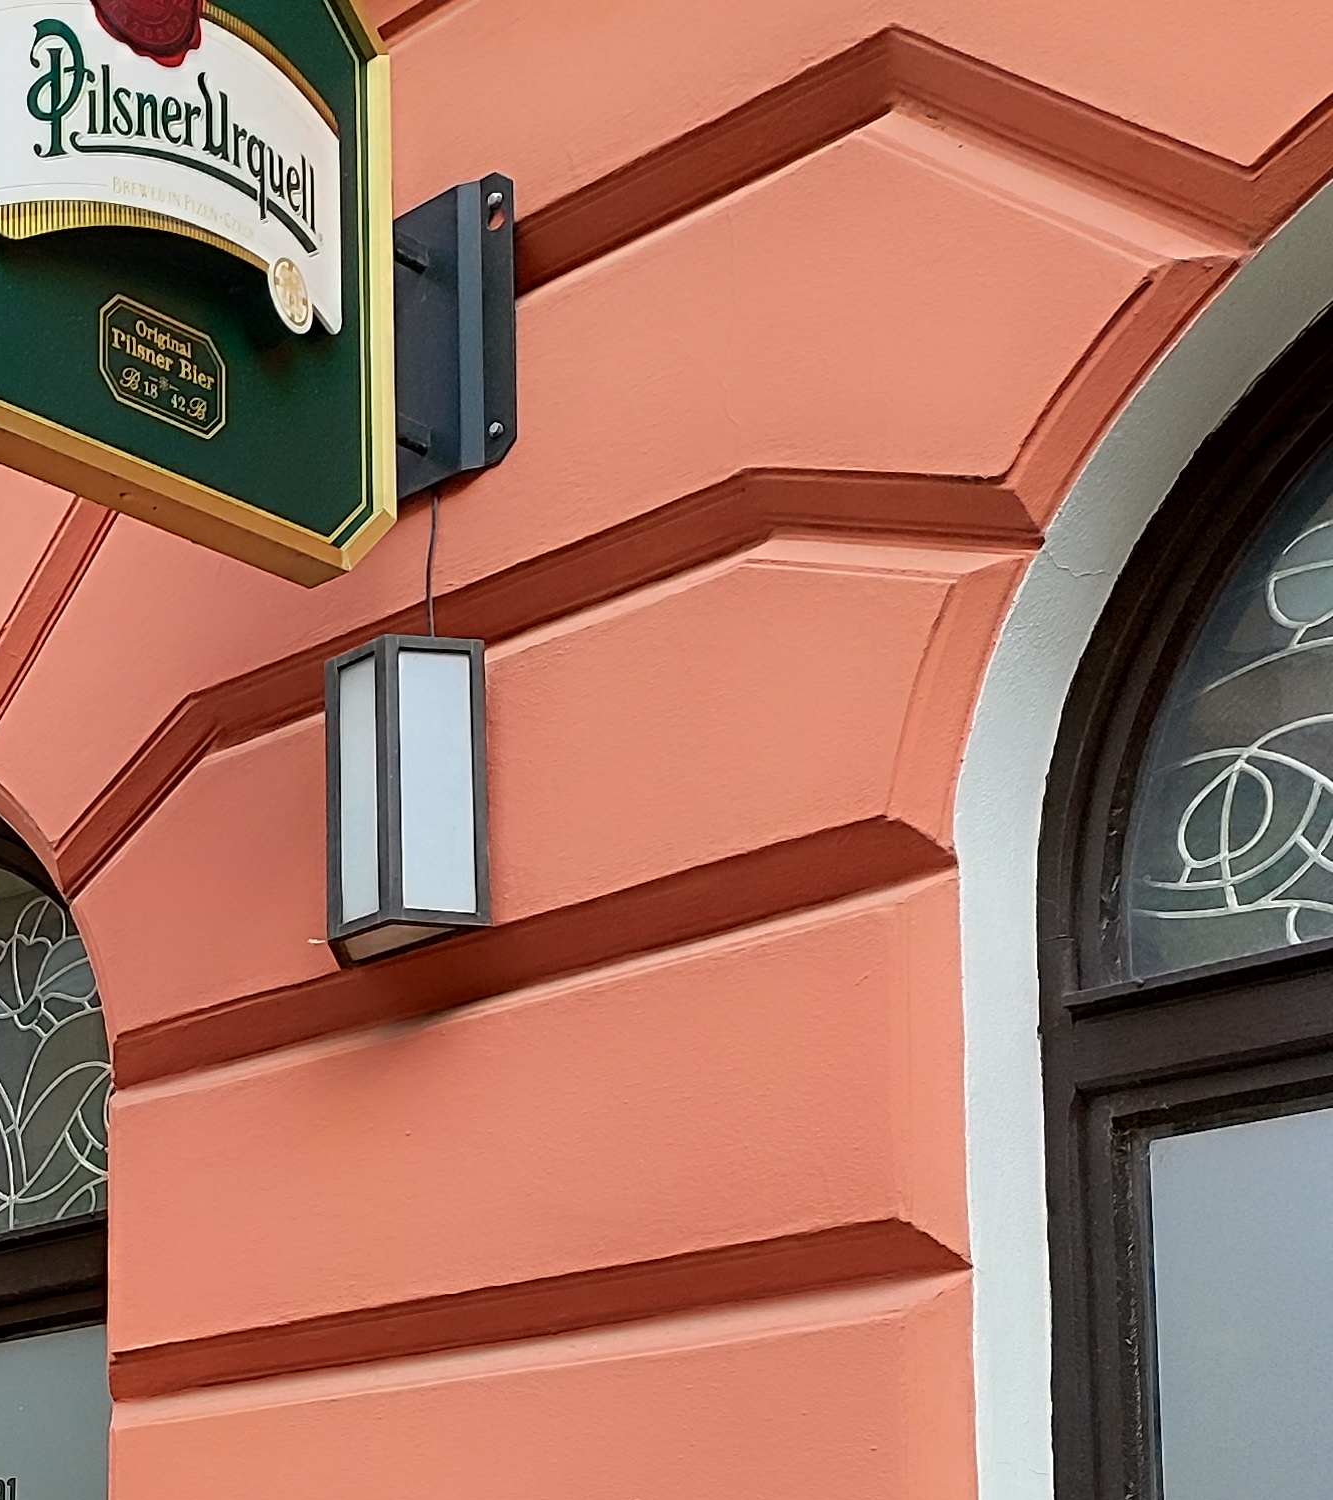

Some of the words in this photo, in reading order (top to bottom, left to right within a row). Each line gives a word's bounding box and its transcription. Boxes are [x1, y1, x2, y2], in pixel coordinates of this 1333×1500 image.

[27, 18, 201, 158] Pilsner
[198, 72, 316, 234] Urquell
[111, 326, 174, 372] Pilsner
[178, 358, 215, 390] Bier
[135, 319, 192, 359] Original
